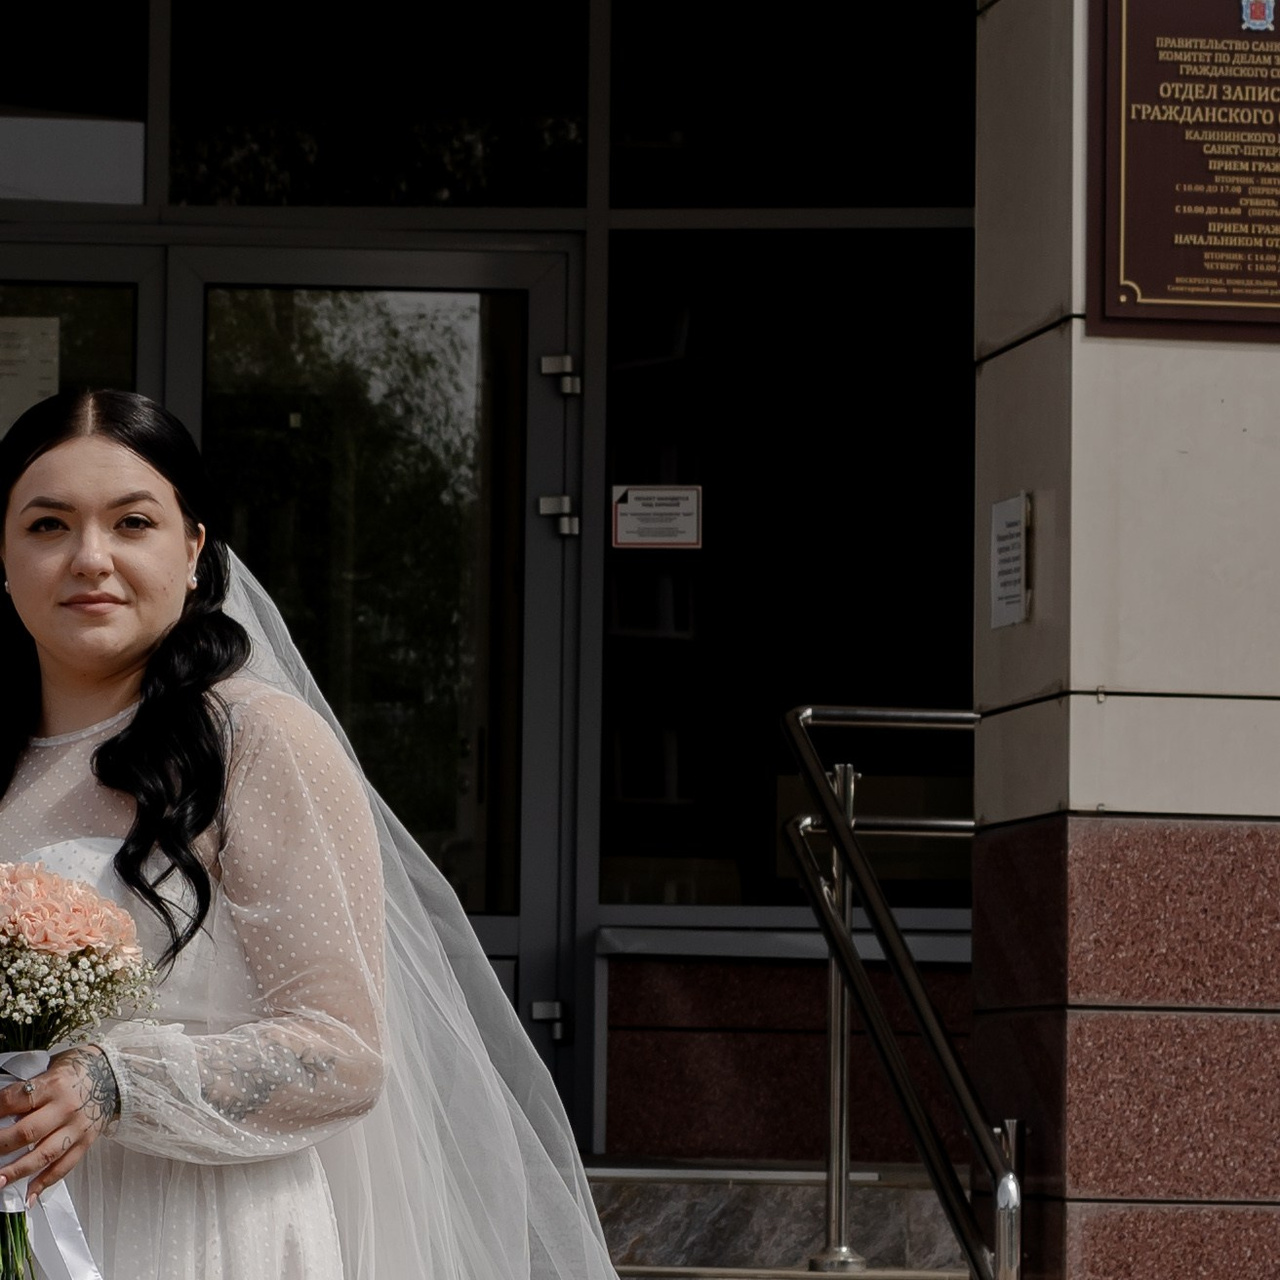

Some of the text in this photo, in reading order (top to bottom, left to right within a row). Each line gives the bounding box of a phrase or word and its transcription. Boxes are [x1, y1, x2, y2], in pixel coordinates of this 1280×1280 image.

[1156, 37, 1249, 51] ПРАВИТЕЛЬСТВО
[1158, 50, 1212, 62] КОМИТЕТ
[1214, 53, 1230, 64] ПО
[1232, 53, 1272, 65] ДЕЛАМ
[1179, 64, 1268, 78] ГРАЖДАНСКОГО
[1159, 82, 1280, 103] ОТДЕЛ ЗАПИС
[1131, 103, 1274, 125] ГРАЖДАНСКОГО
[1185, 130, 1276, 143] КАЛИНИНСКОГО
[1208, 160, 1249, 171] ПРИЕМ
[1208, 222, 1249, 233] ПРИЕМ
[1174, 234, 1280, 248] НАЧАЛЬНИКОМ ОТ
